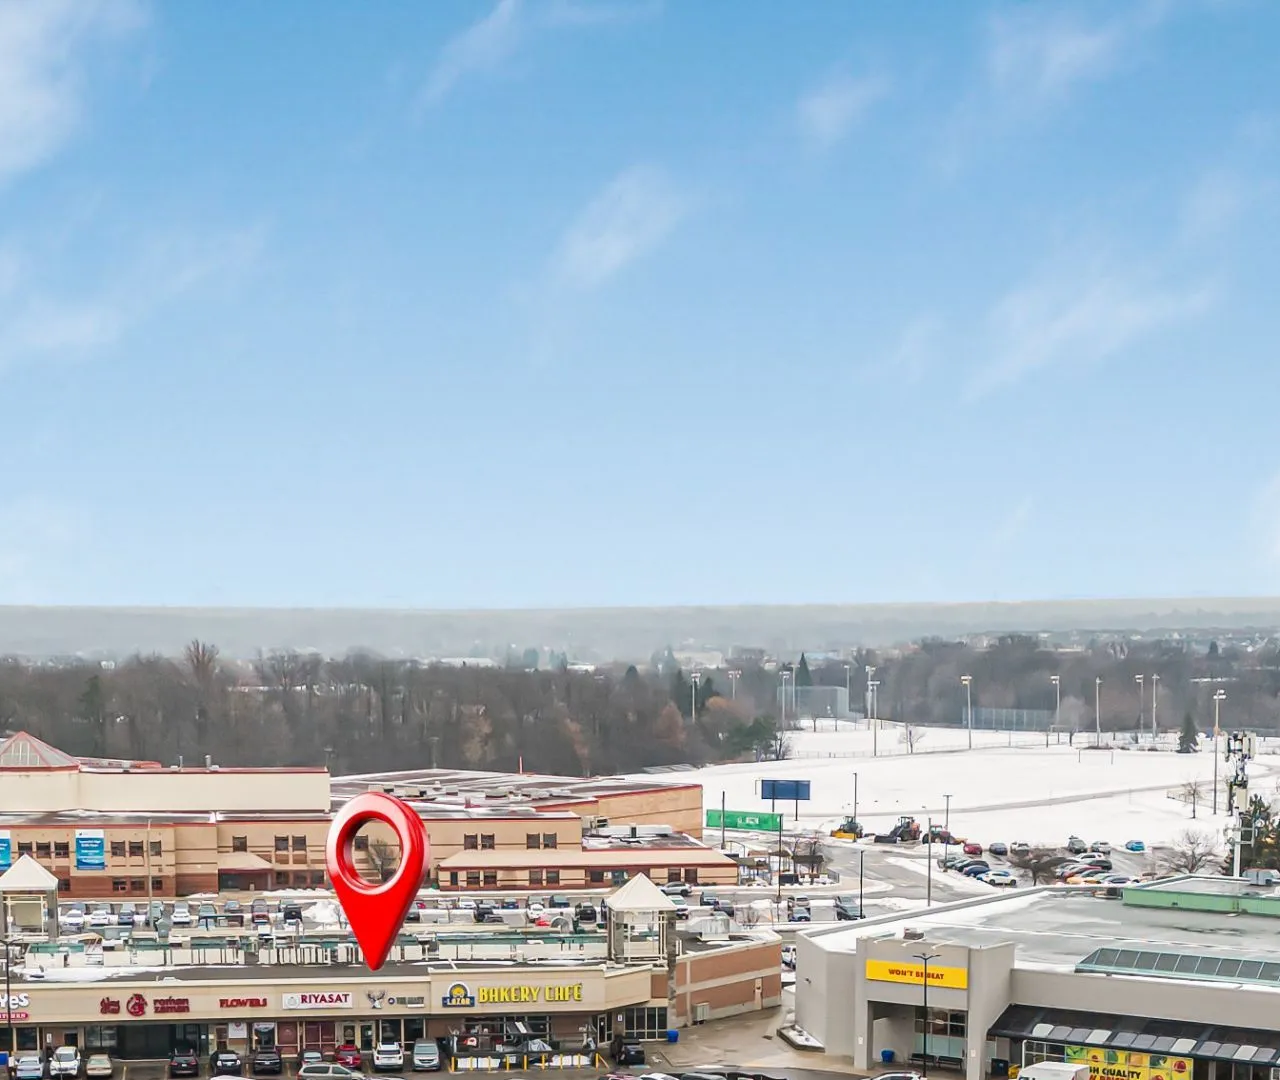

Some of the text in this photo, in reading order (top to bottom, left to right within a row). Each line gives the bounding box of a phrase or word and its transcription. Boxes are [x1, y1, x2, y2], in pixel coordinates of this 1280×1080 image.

[888, 968, 914, 977] WON'T
[478, 982, 583, 1003] BAKERY CAFÉ
[219, 998, 268, 1008] FLOWERS
[300, 994, 350, 1004] RIYASAT
[1101, 1068, 1142, 1080] QUALITY
